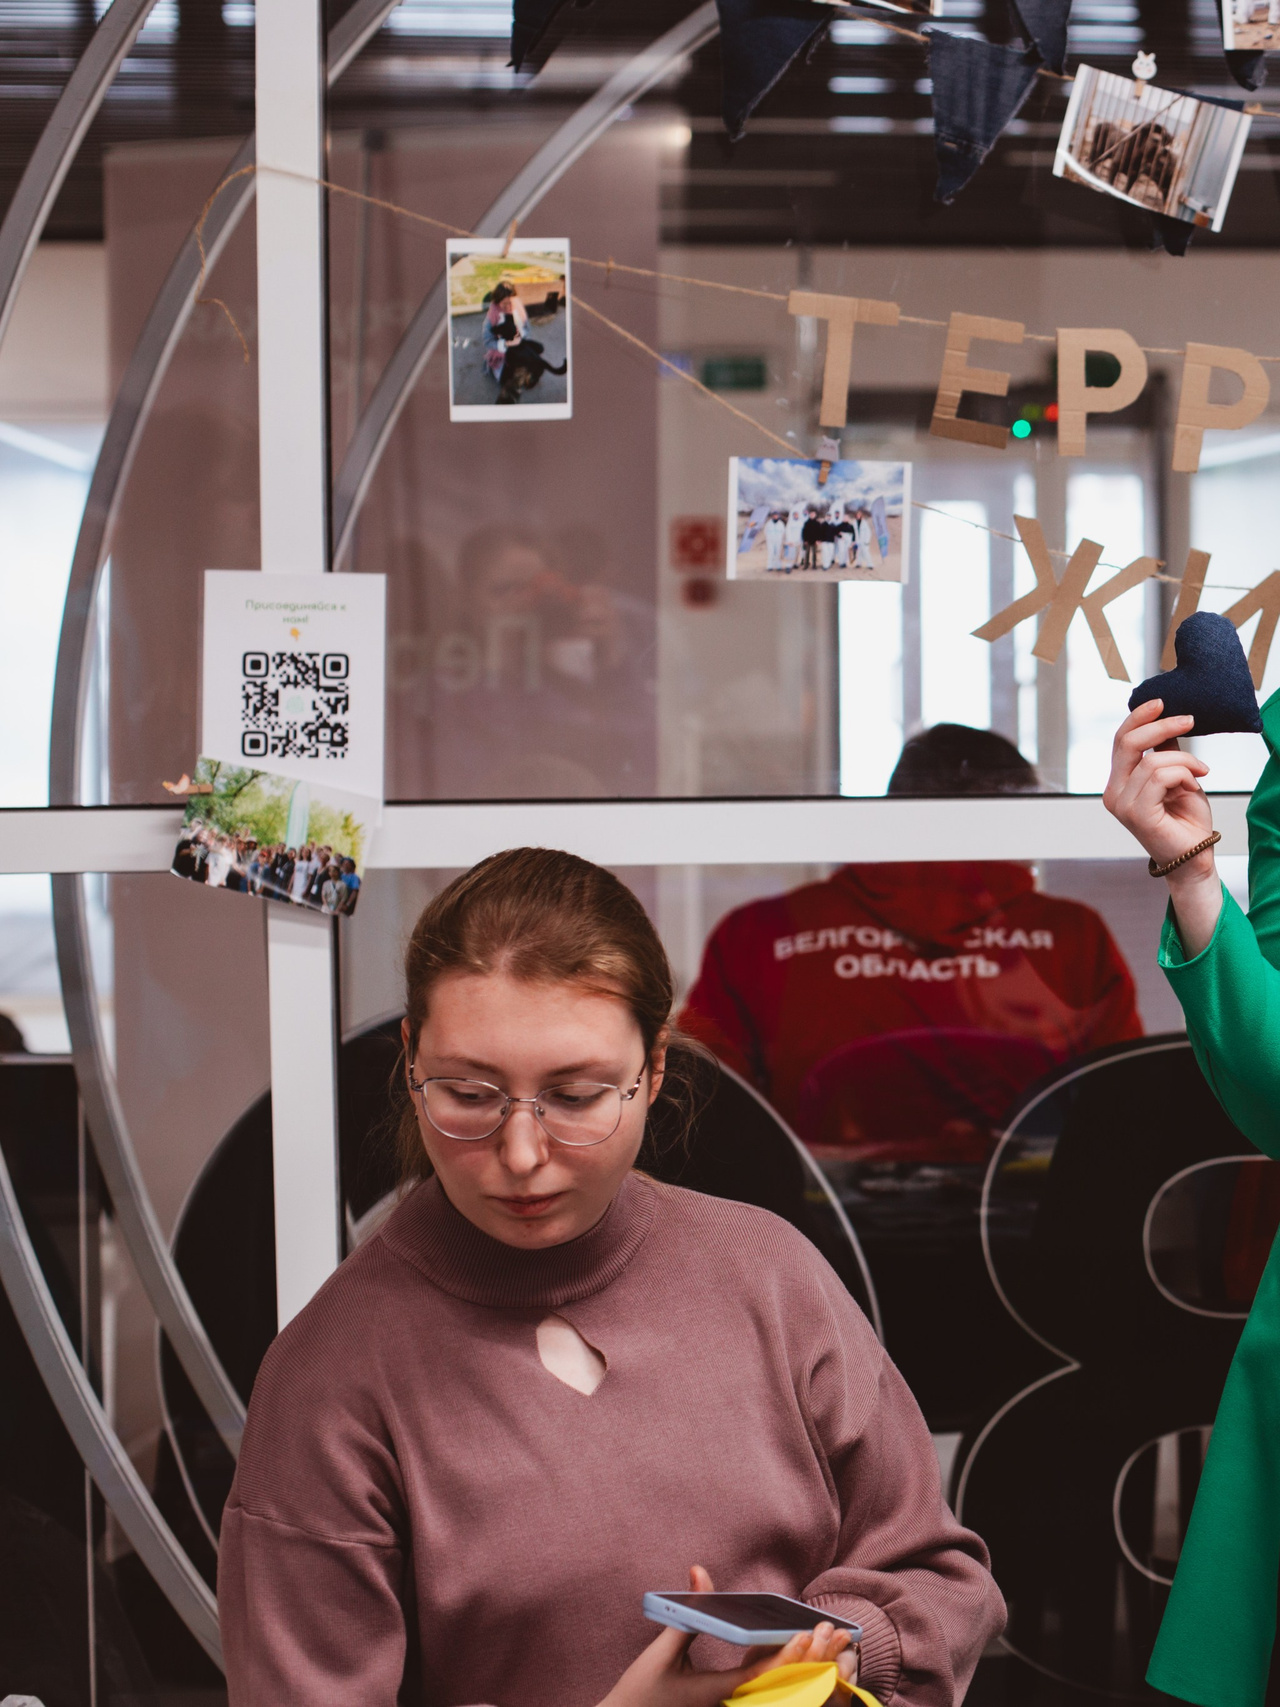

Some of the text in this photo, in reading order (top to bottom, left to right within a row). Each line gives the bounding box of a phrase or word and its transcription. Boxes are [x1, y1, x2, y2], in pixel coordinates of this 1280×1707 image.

[245, 600, 337, 612] Присоединяйся
[282, 615, 309, 624] нам!
[773, 925, 1054, 961] БЕЛГОРСКАЯ
[834, 953, 1000, 982] ОБЛАСТЬ
